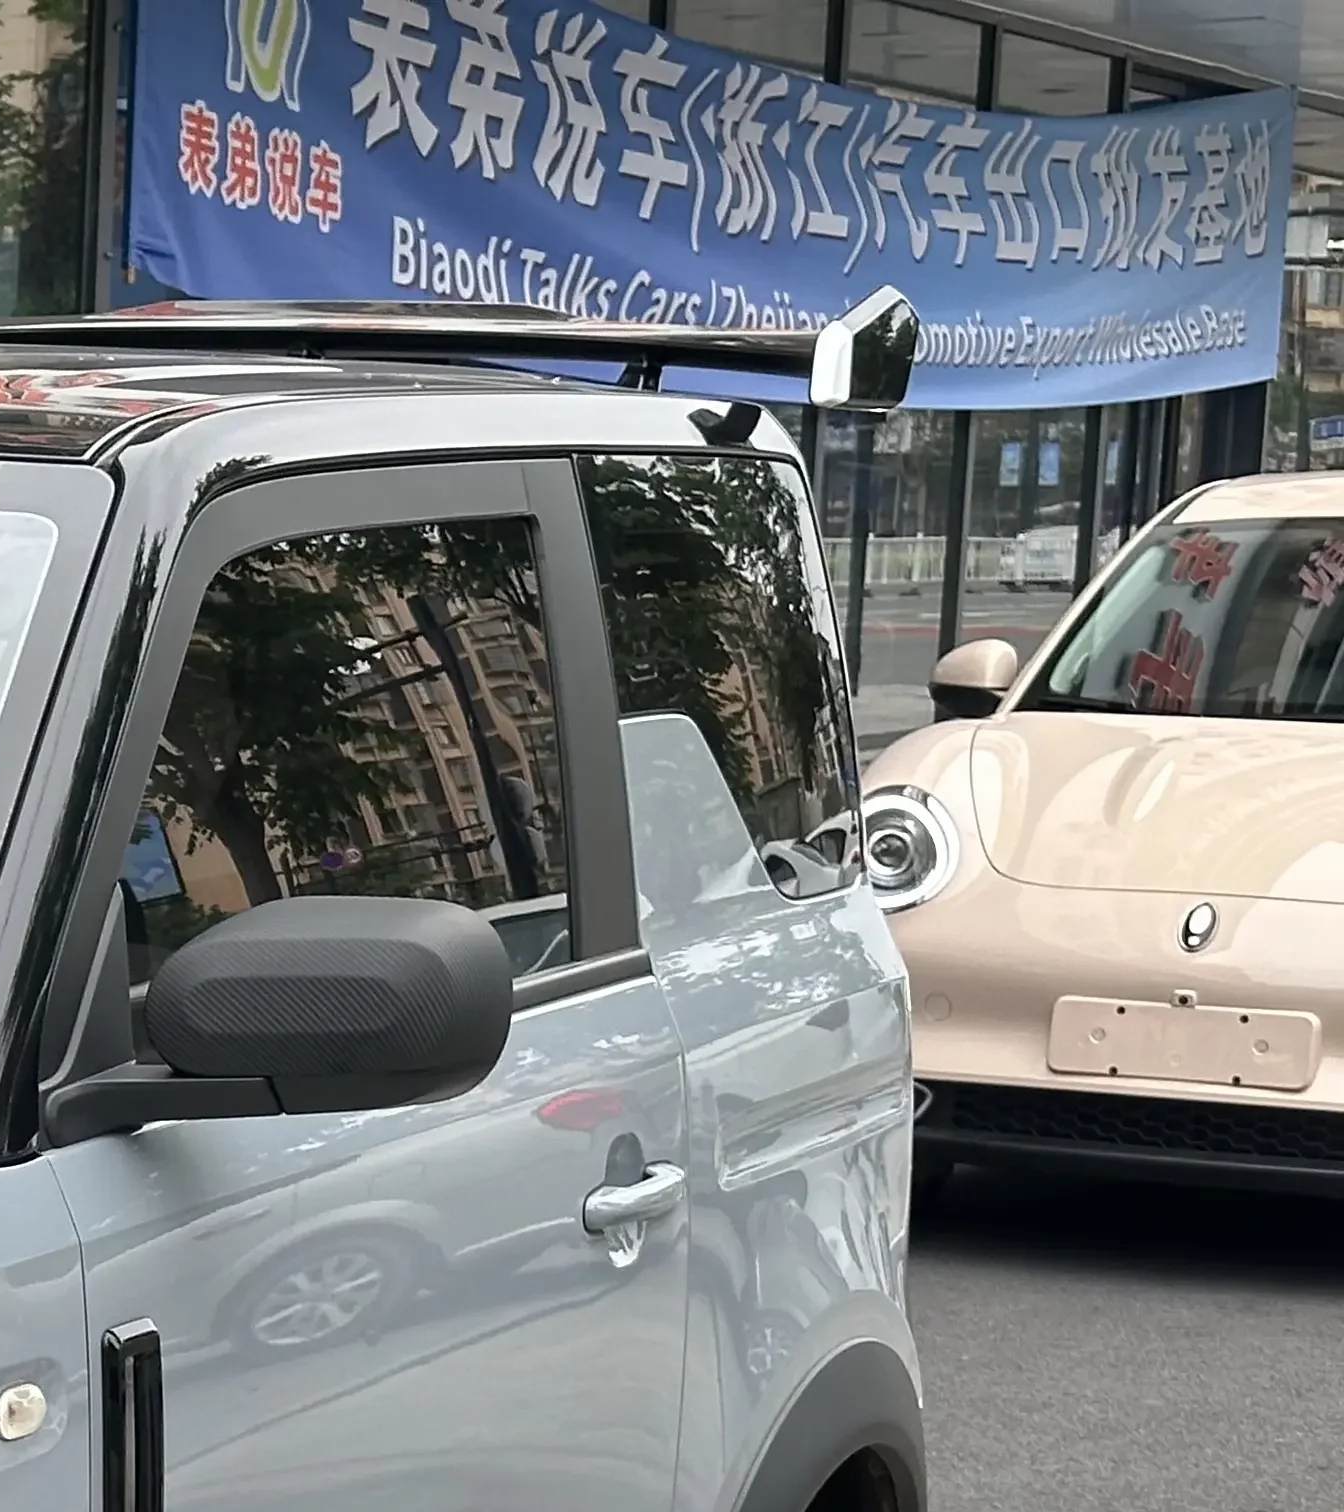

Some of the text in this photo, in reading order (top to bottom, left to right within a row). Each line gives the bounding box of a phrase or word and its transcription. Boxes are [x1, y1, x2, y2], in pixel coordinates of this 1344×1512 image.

[178, 100, 342, 233] 表弟说车
[393, 215, 512, 304] Biaodi
[520, 247, 618, 322] Talks
[618, 268, 703, 326] Cars
[914, 309, 1016, 365] omotive
[1014, 316, 1096, 379] Export
